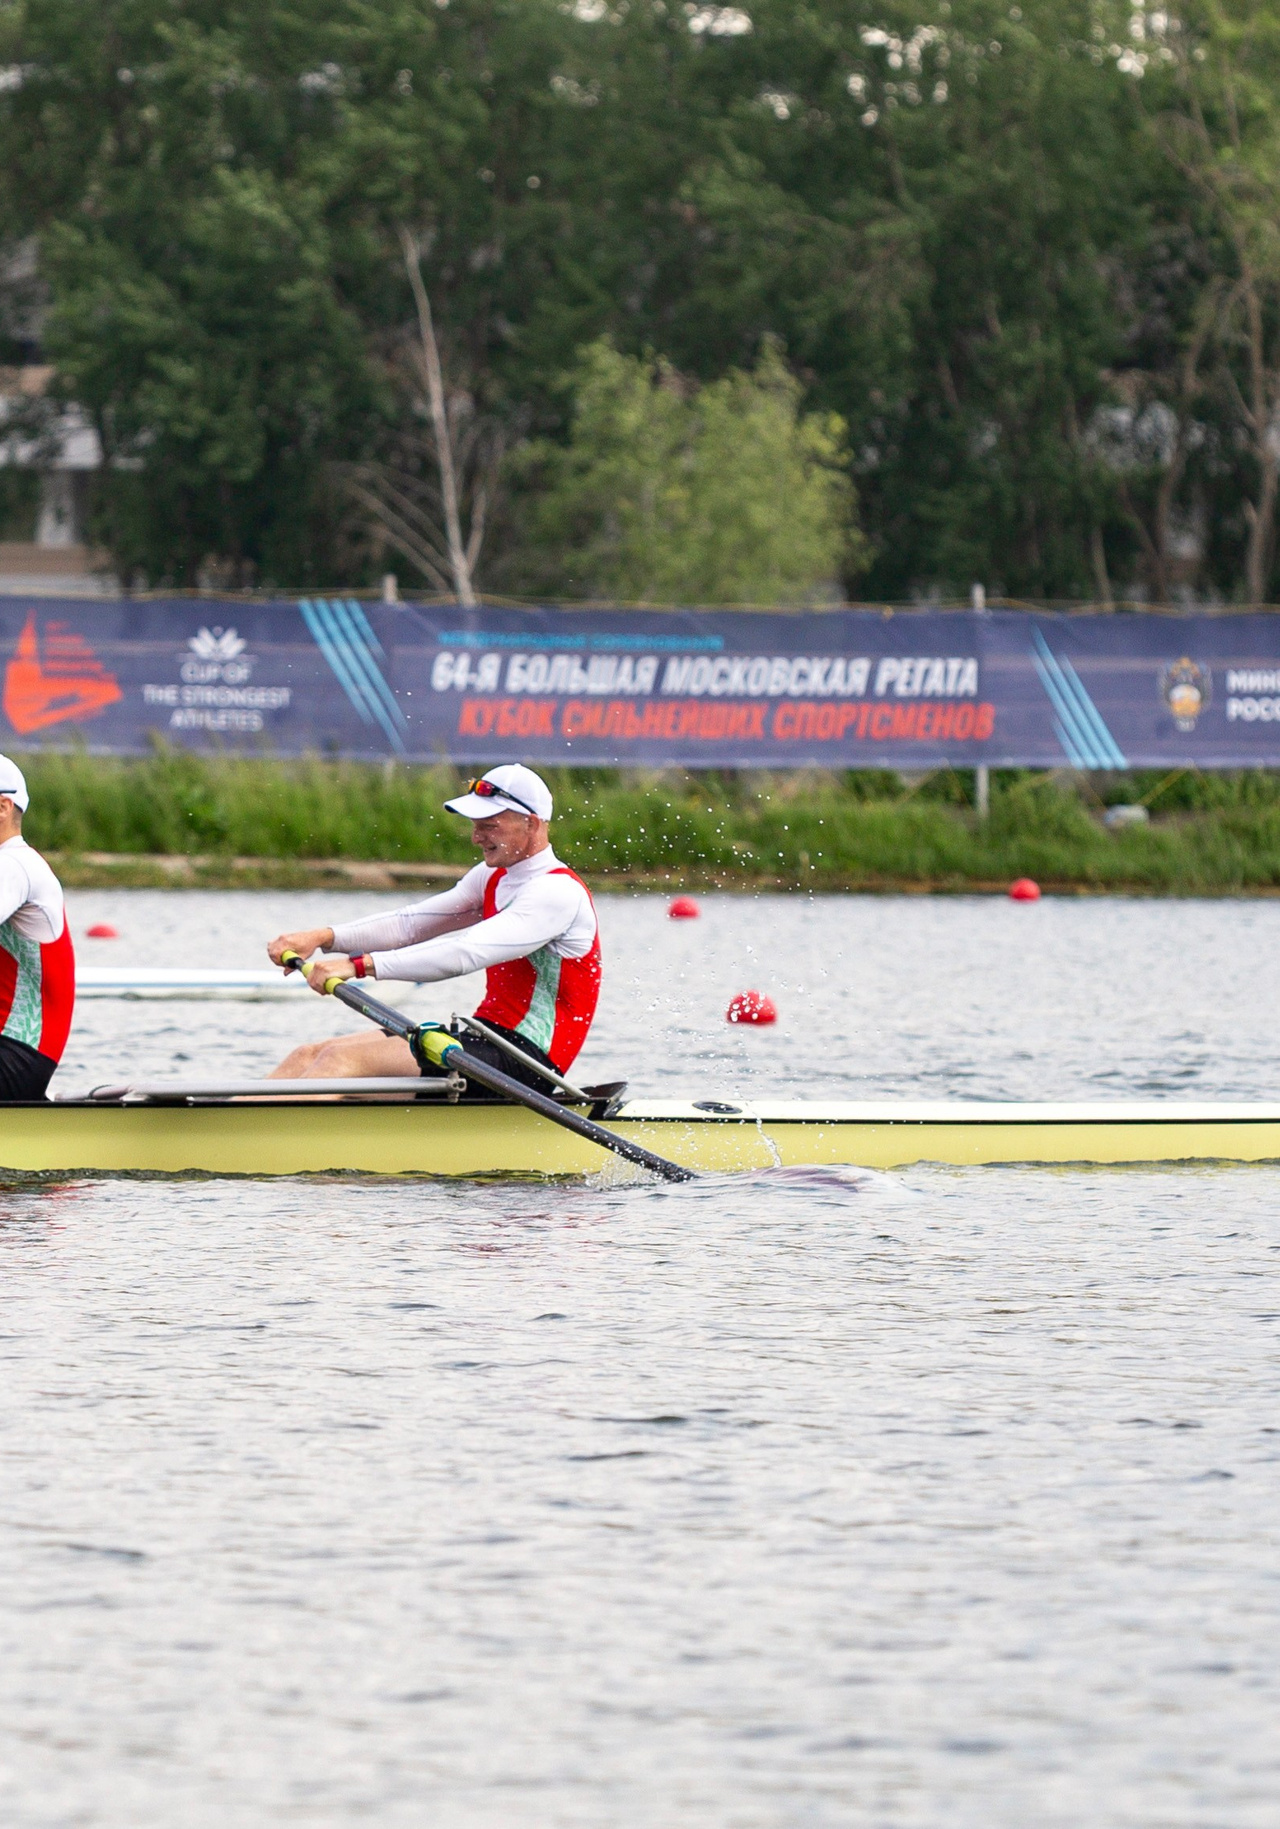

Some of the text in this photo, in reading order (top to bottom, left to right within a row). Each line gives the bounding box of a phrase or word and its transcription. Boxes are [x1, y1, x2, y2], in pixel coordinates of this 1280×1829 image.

[430, 651, 978, 697] 64-Я БОЛЬШАЯ МОСКОВСКАЯ РЕГАТА
[1226, 669, 1280, 694] МИН
[458, 699, 557, 737] КУБОК
[773, 702, 995, 741] СПОРТСМЕНОВ
